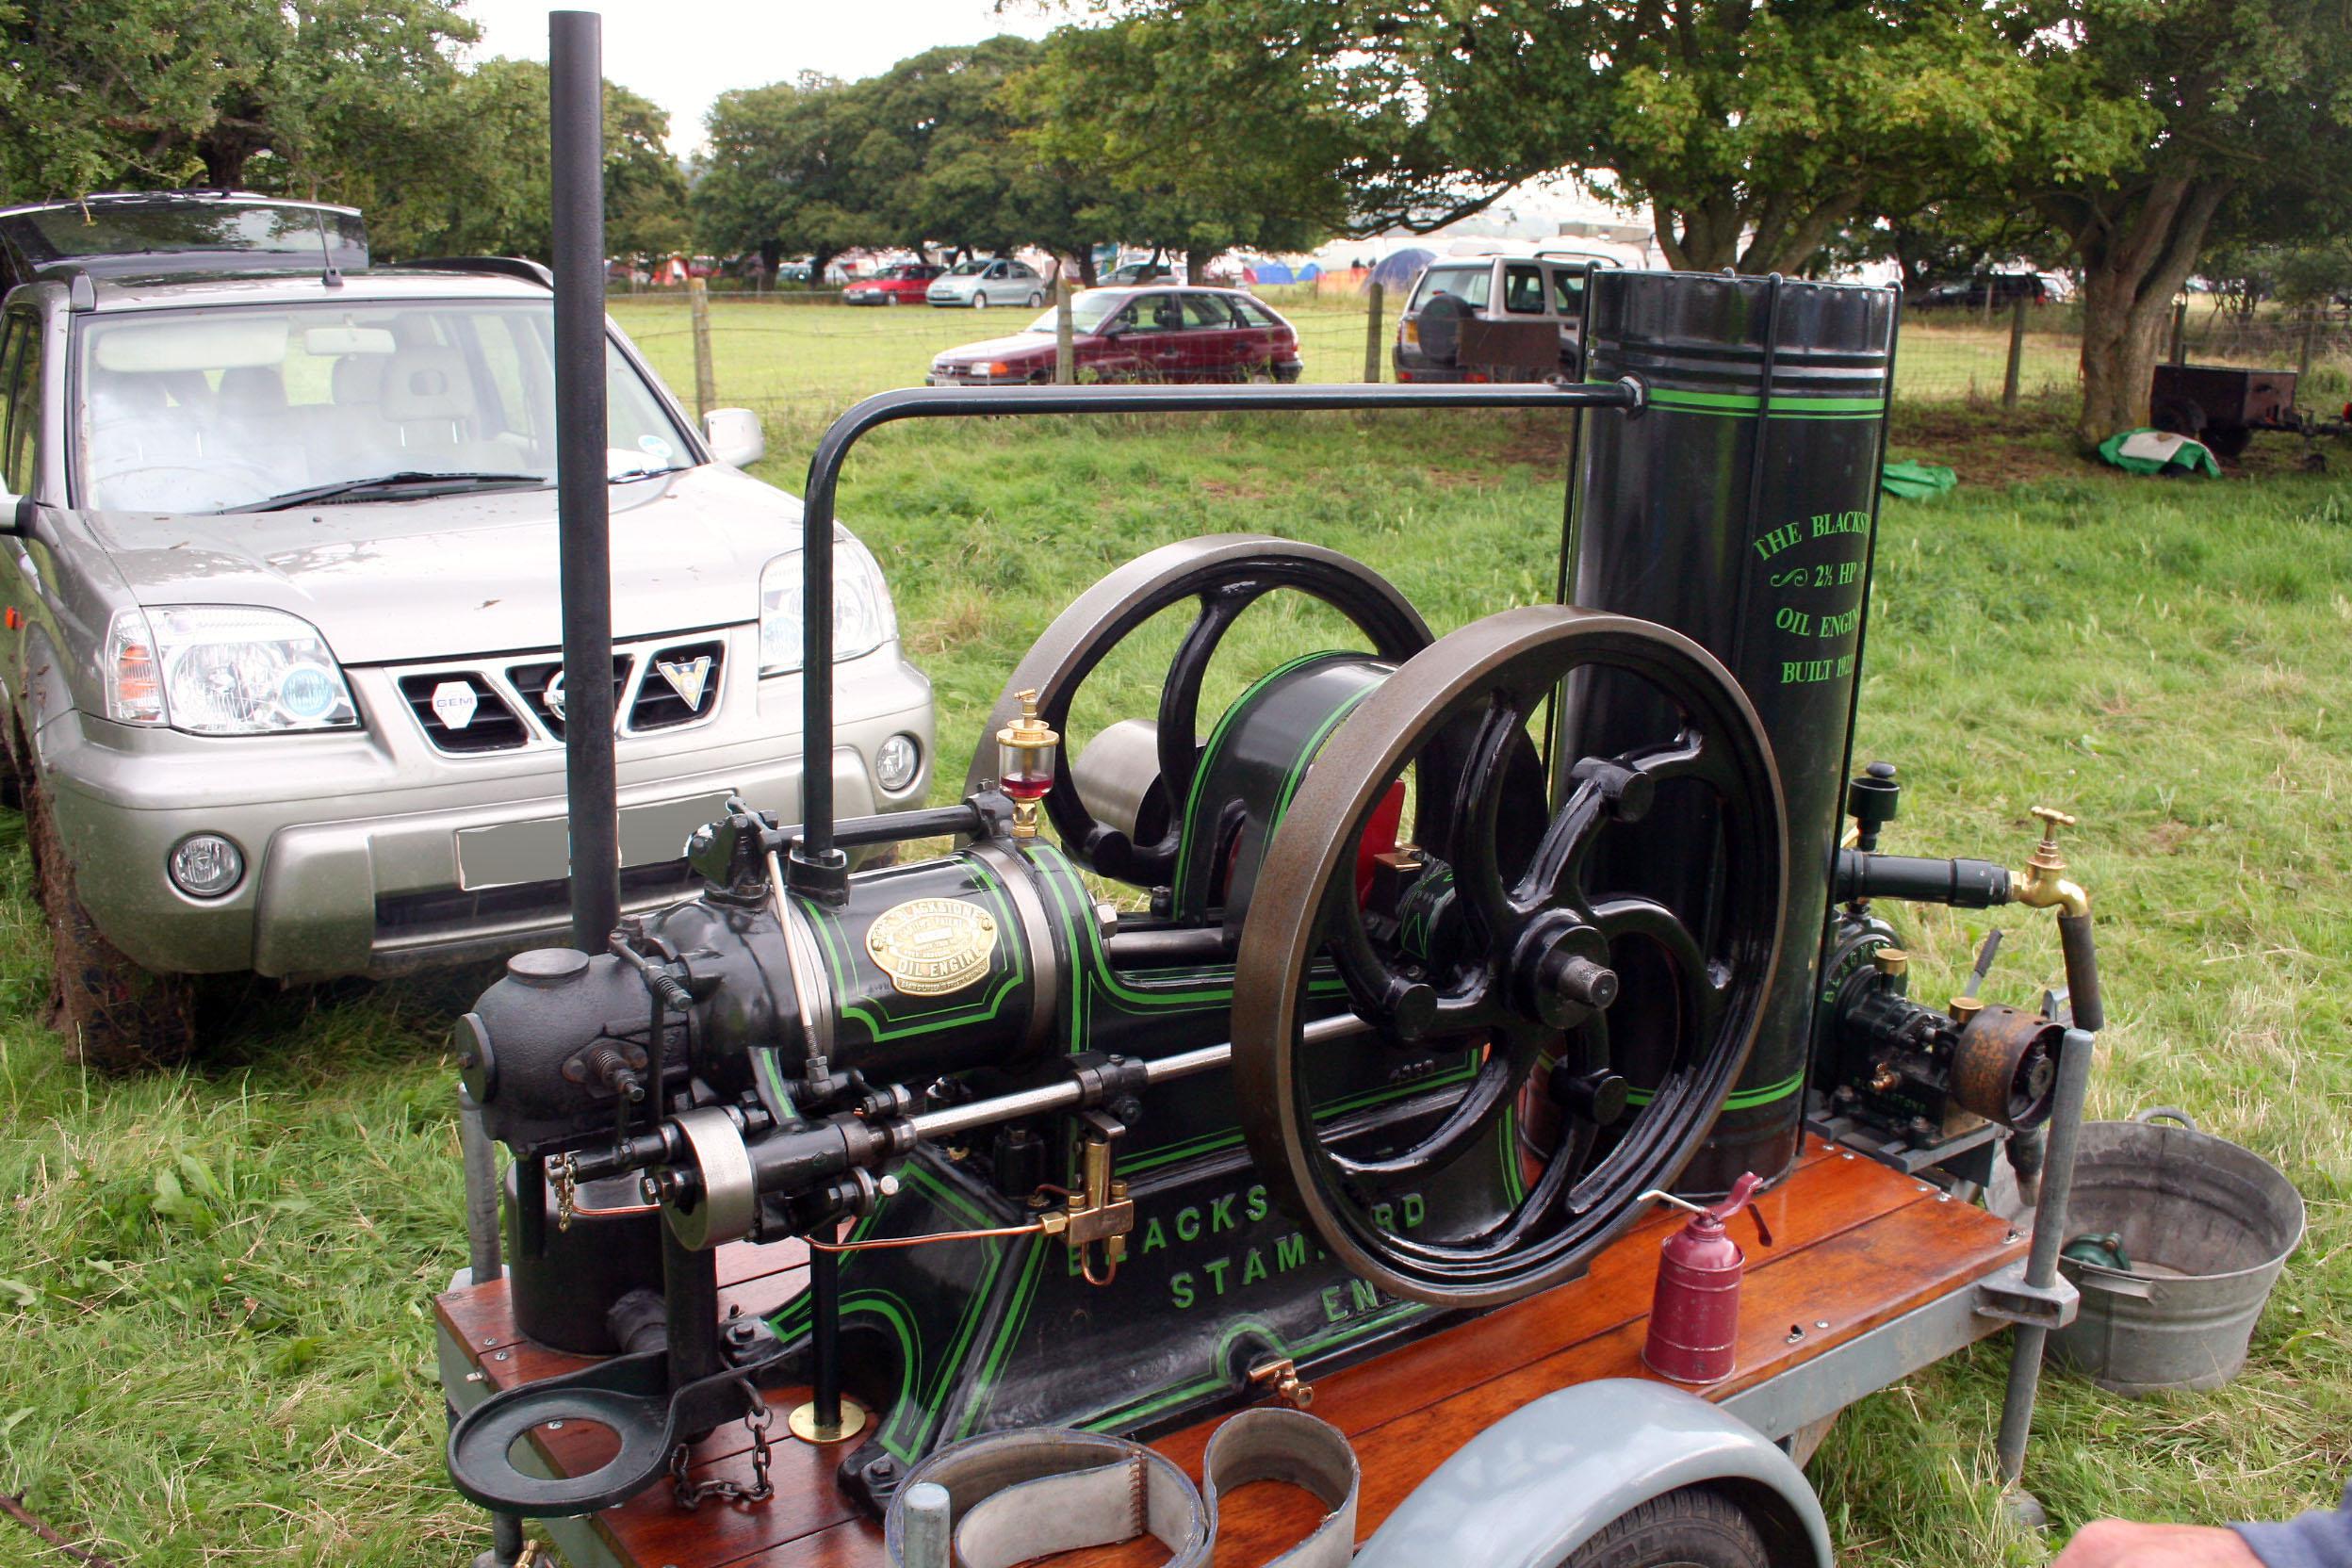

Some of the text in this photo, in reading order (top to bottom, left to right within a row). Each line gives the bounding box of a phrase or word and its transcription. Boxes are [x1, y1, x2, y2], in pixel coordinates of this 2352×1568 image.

[1753, 522, 1802, 561] THE
[1838, 562, 1856, 585] HP
[1775, 608, 1810, 636] OIL
[1780, 659, 1833, 684] BUILT
[436, 697, 473, 709] GEM
[898, 956, 923, 976] OIL
[930, 946, 983, 977] ENGINE
